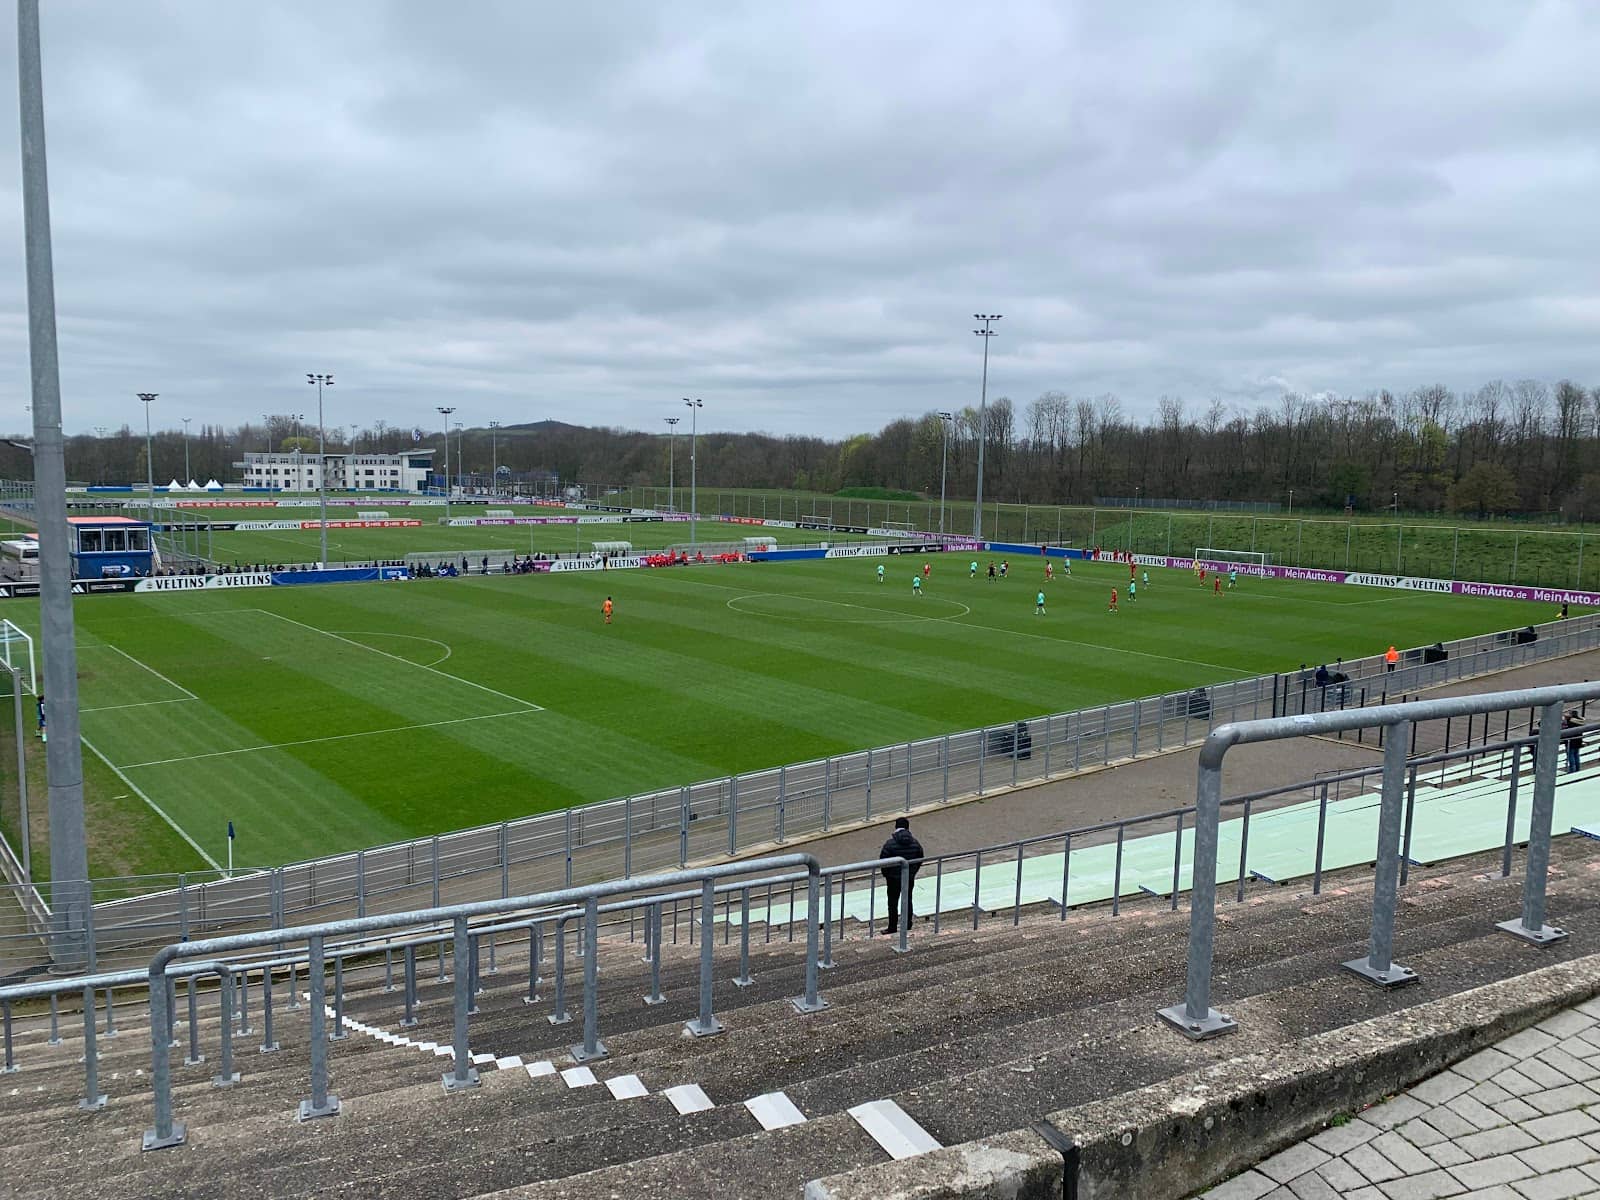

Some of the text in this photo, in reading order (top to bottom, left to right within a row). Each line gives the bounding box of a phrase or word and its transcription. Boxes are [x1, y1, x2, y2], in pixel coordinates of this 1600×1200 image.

[563, 560, 595, 570] VELTINS
[609, 559, 639, 568] VELTINS
[1173, 559, 1218, 571] Meinto.de
[225, 574, 271, 586] VELTINS
[1285, 569, 1337, 582] MeinAuto.de
[1360, 575, 1396, 587] VELTINS
[155, 578, 204, 590] VELTINS
[1412, 580, 1451, 592] VELTINS
[1461, 583, 1528, 599] MeinAuto.de
